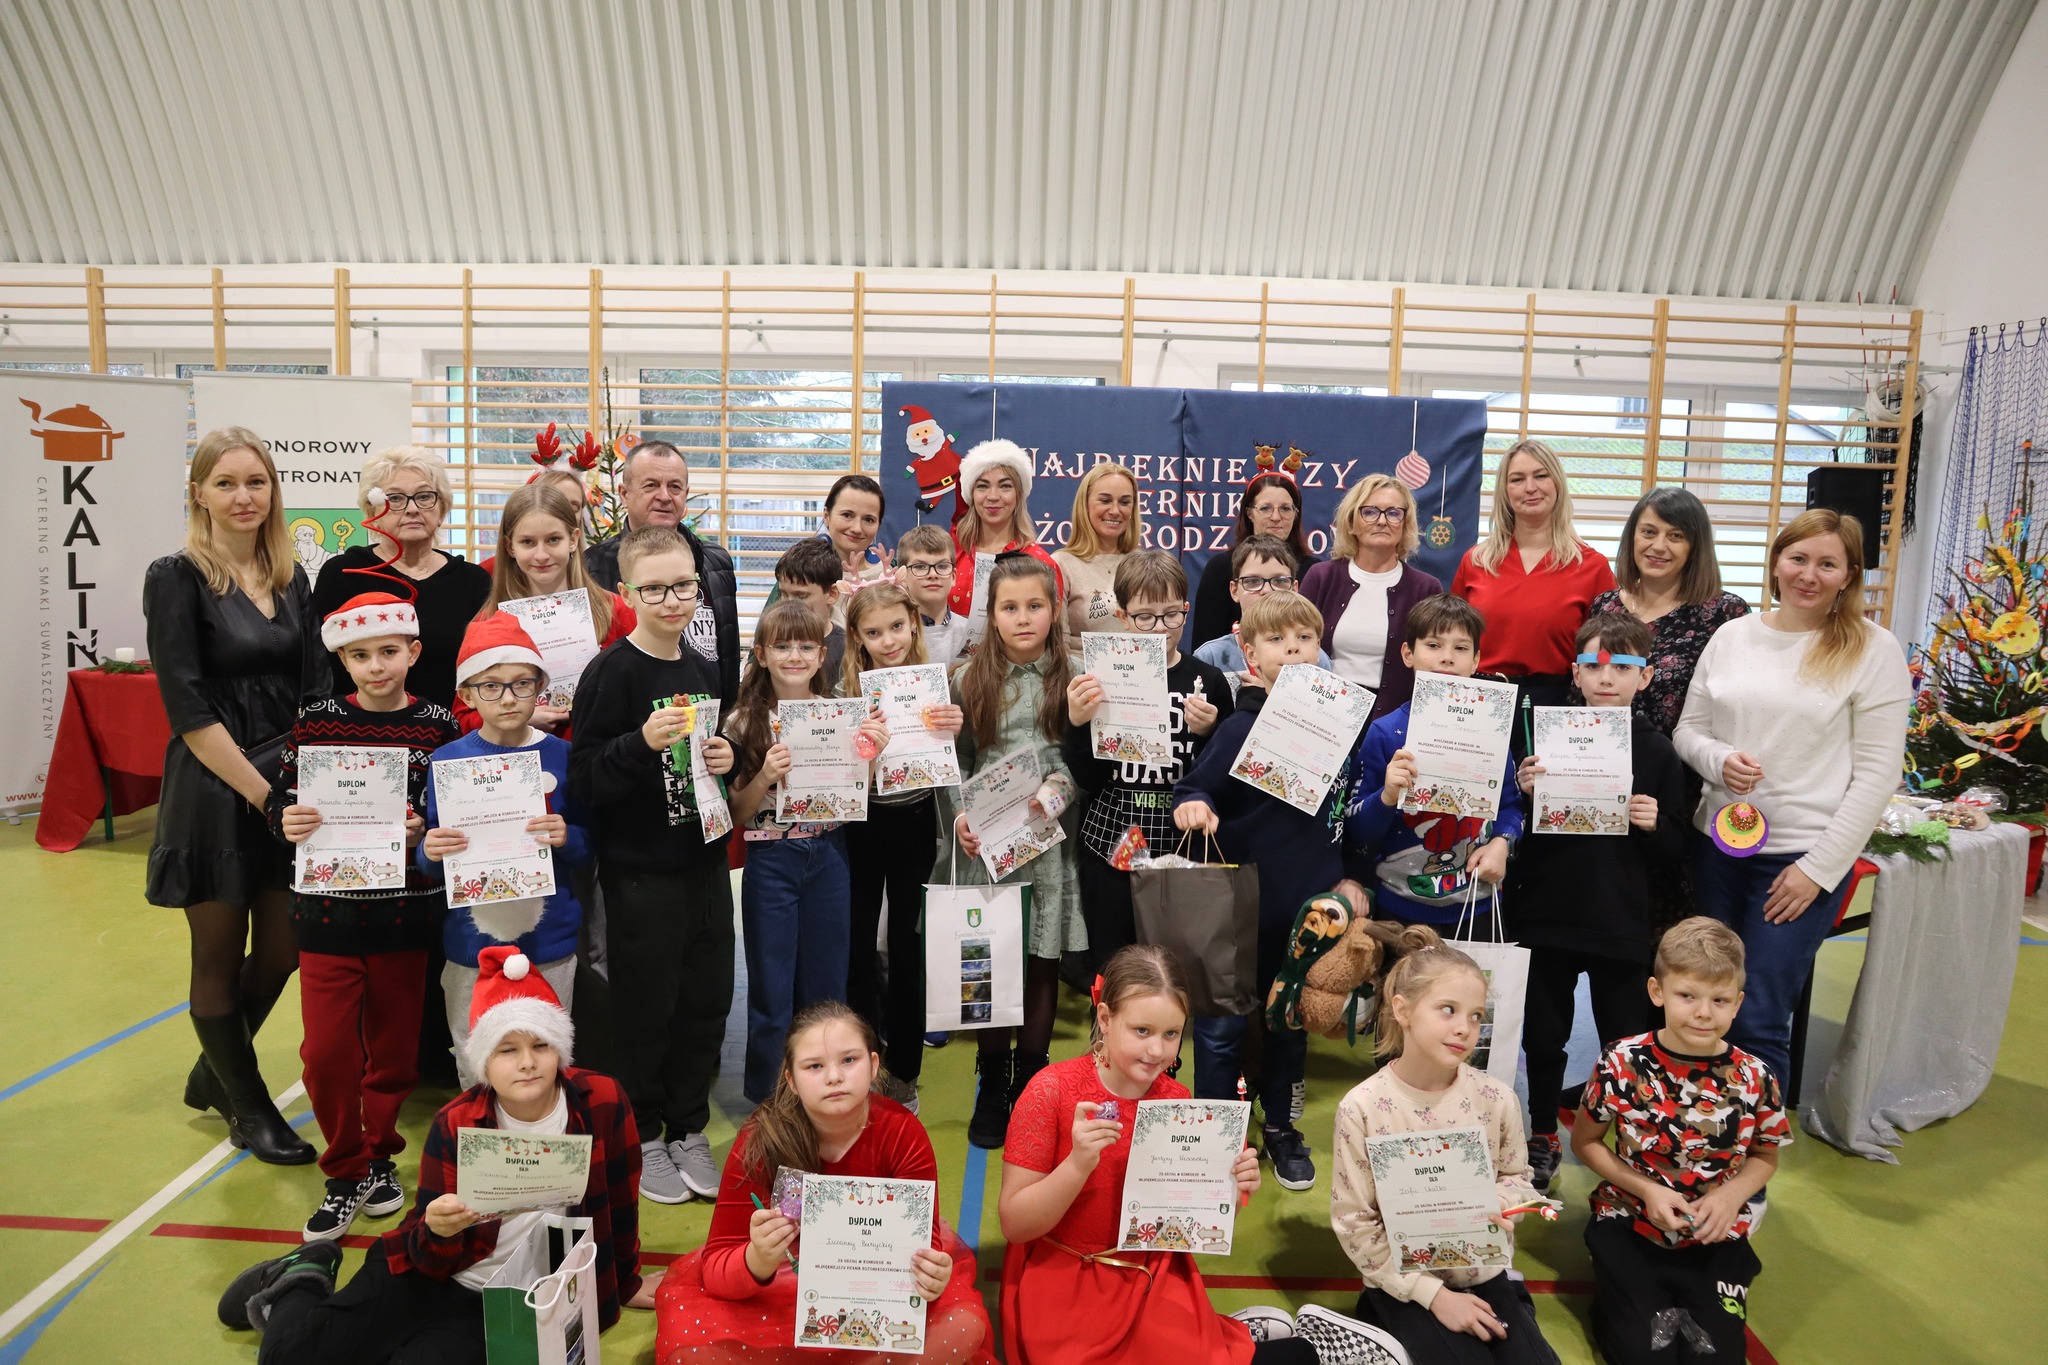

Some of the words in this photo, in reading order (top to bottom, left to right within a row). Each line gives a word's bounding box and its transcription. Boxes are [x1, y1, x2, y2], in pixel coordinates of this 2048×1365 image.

[262, 440, 372, 454] ONOROWY
[277, 470, 362, 483] TRONAT
[1138, 489, 1244, 518] ERNIK
[37, 476, 48, 554] CATERING
[39, 566, 50, 610] SMAKI
[532, 610, 556, 620] DYPLOM
[40, 621, 54, 740] SUWALSZCZYZNY
[894, 694, 916, 702] DYPLOM
[1310, 684, 1336, 702] DYPLOM
[1448, 705, 1474, 716] DYPLOM
[473, 776, 502, 786] DYPLOM
[1289, 1079, 1304, 1122] MARVEL
[1171, 1135, 1201, 1143] DYPLOM
[506, 1157, 540, 1165] DYPLOM
[1414, 1166, 1446, 1175] DYPLOM
[848, 1217, 882, 1226] DYPLOM
